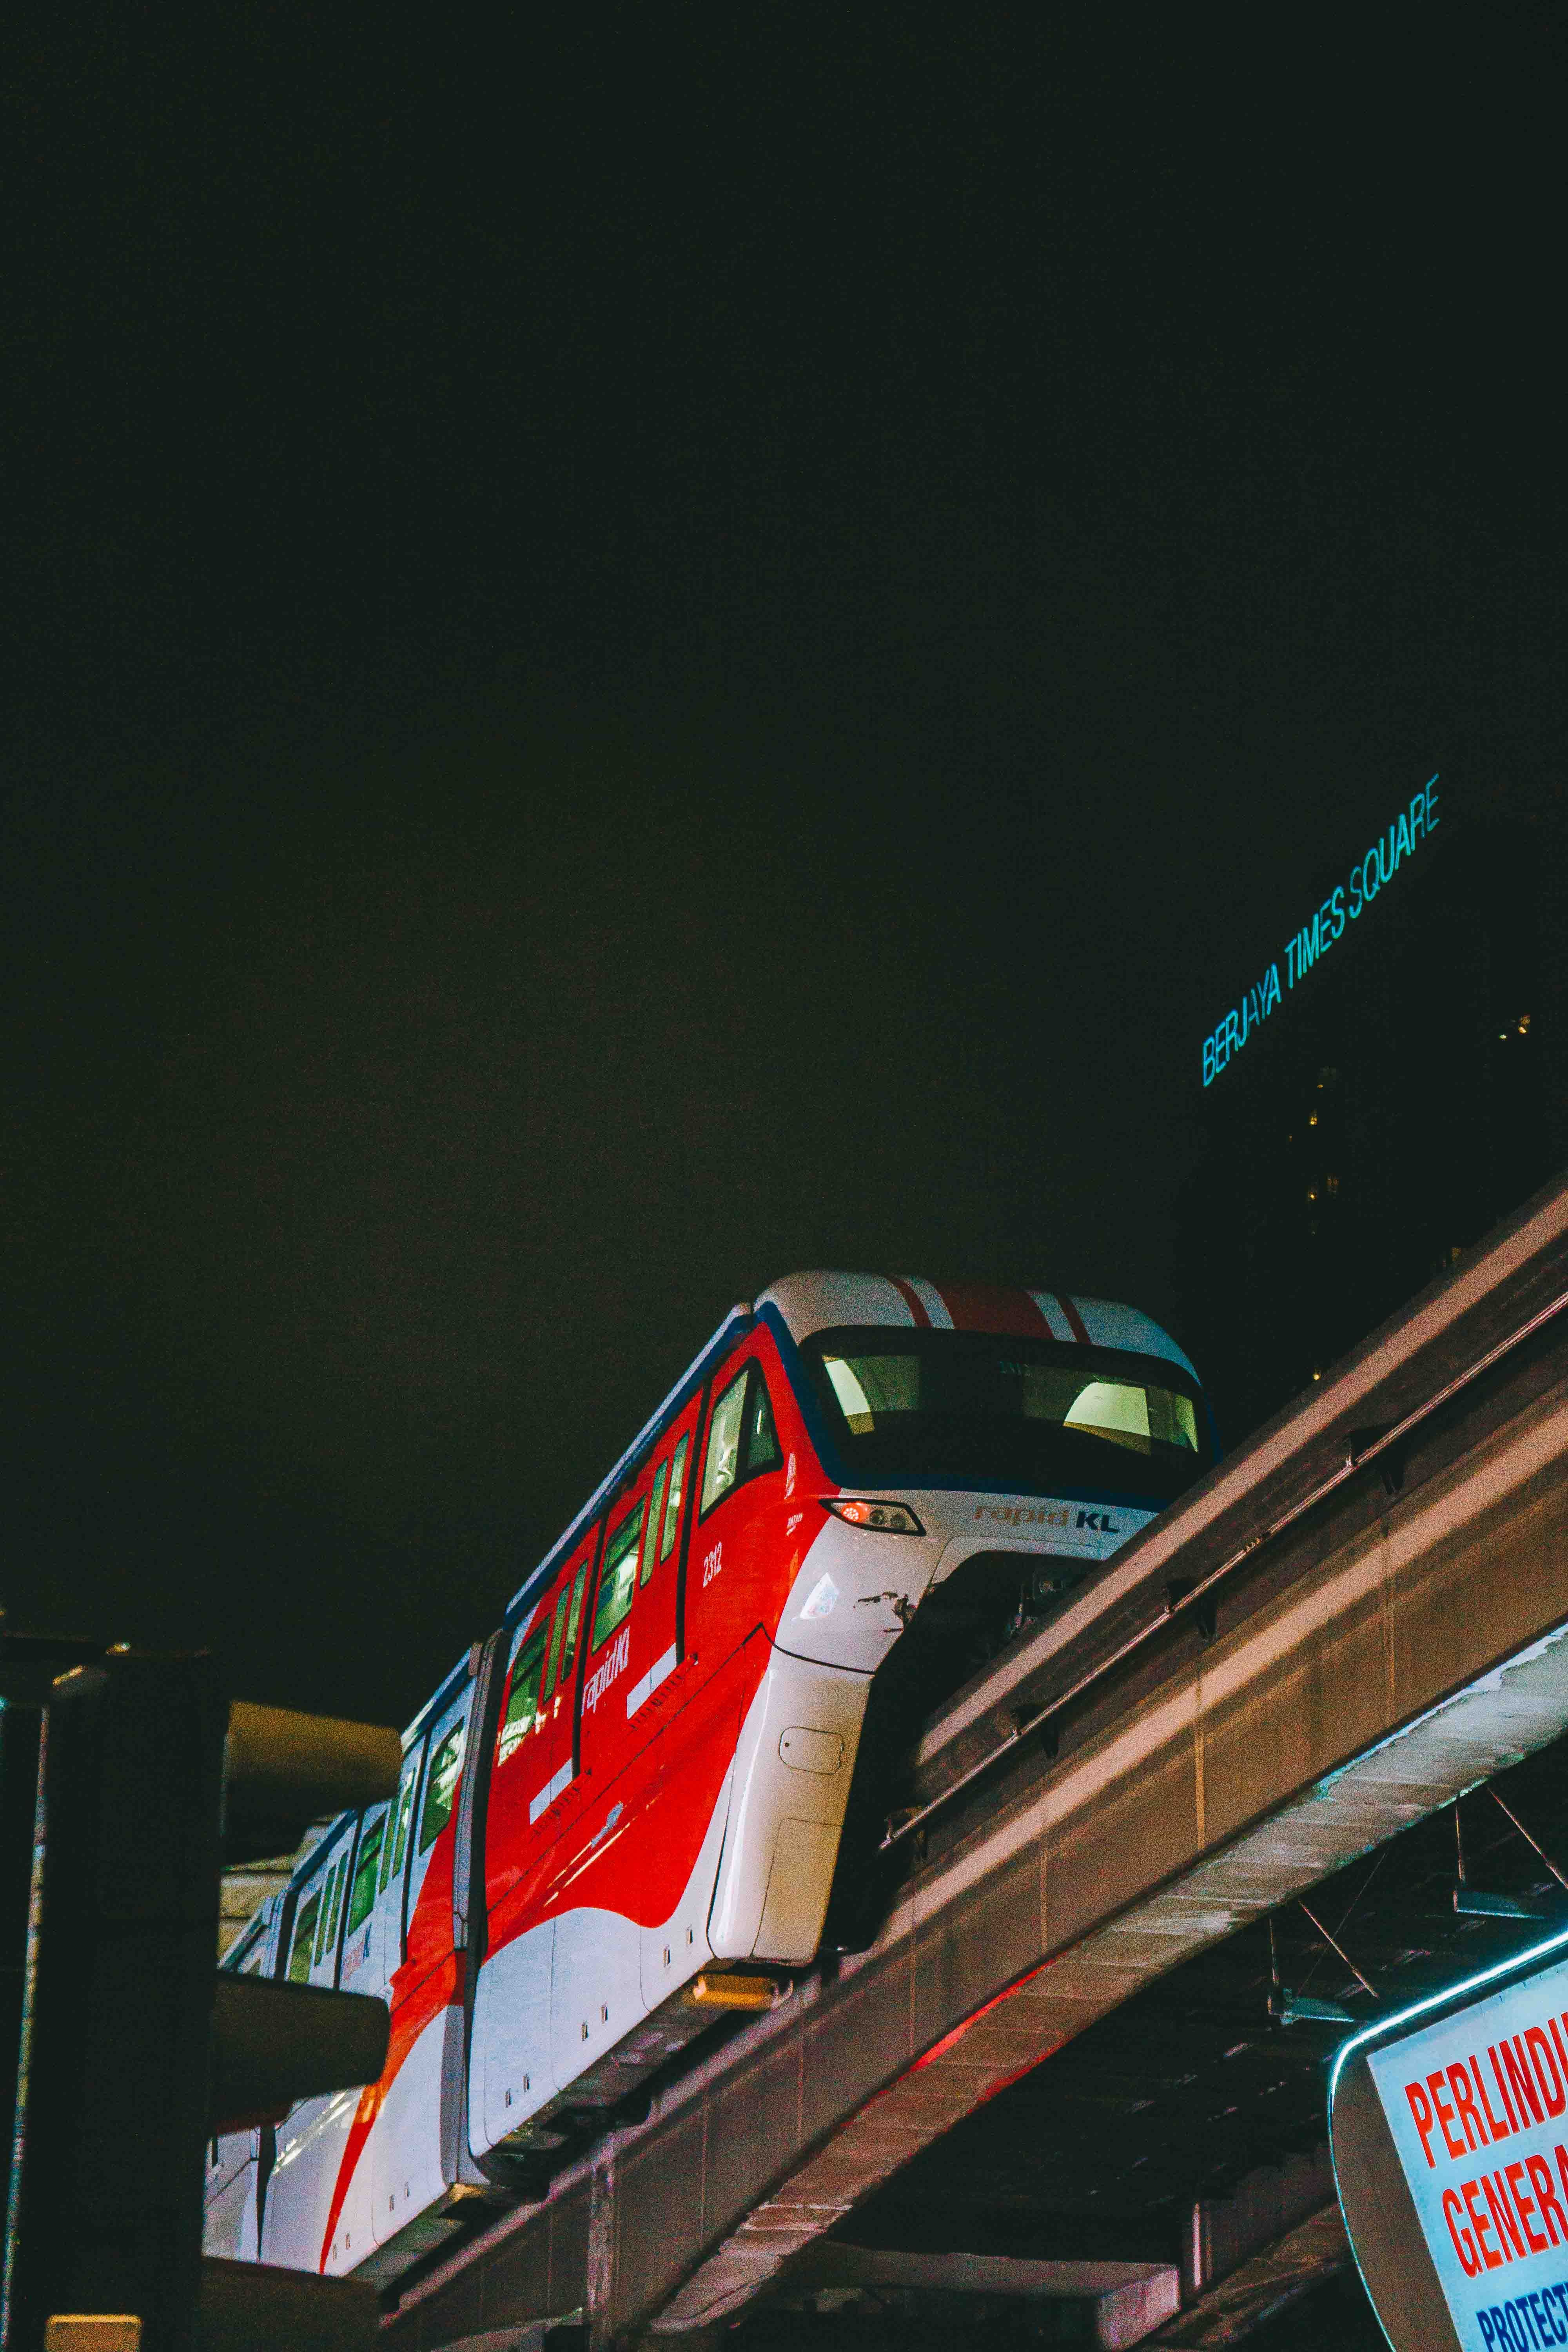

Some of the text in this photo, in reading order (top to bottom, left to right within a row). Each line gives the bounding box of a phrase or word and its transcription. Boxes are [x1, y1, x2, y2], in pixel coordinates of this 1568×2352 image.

[1203, 773, 1440, 1087] BERJAYA TIMES SQUARE
[703, 1541, 722, 1588] 2312
[1475, 2282, 1568, 2352] PROTECT
